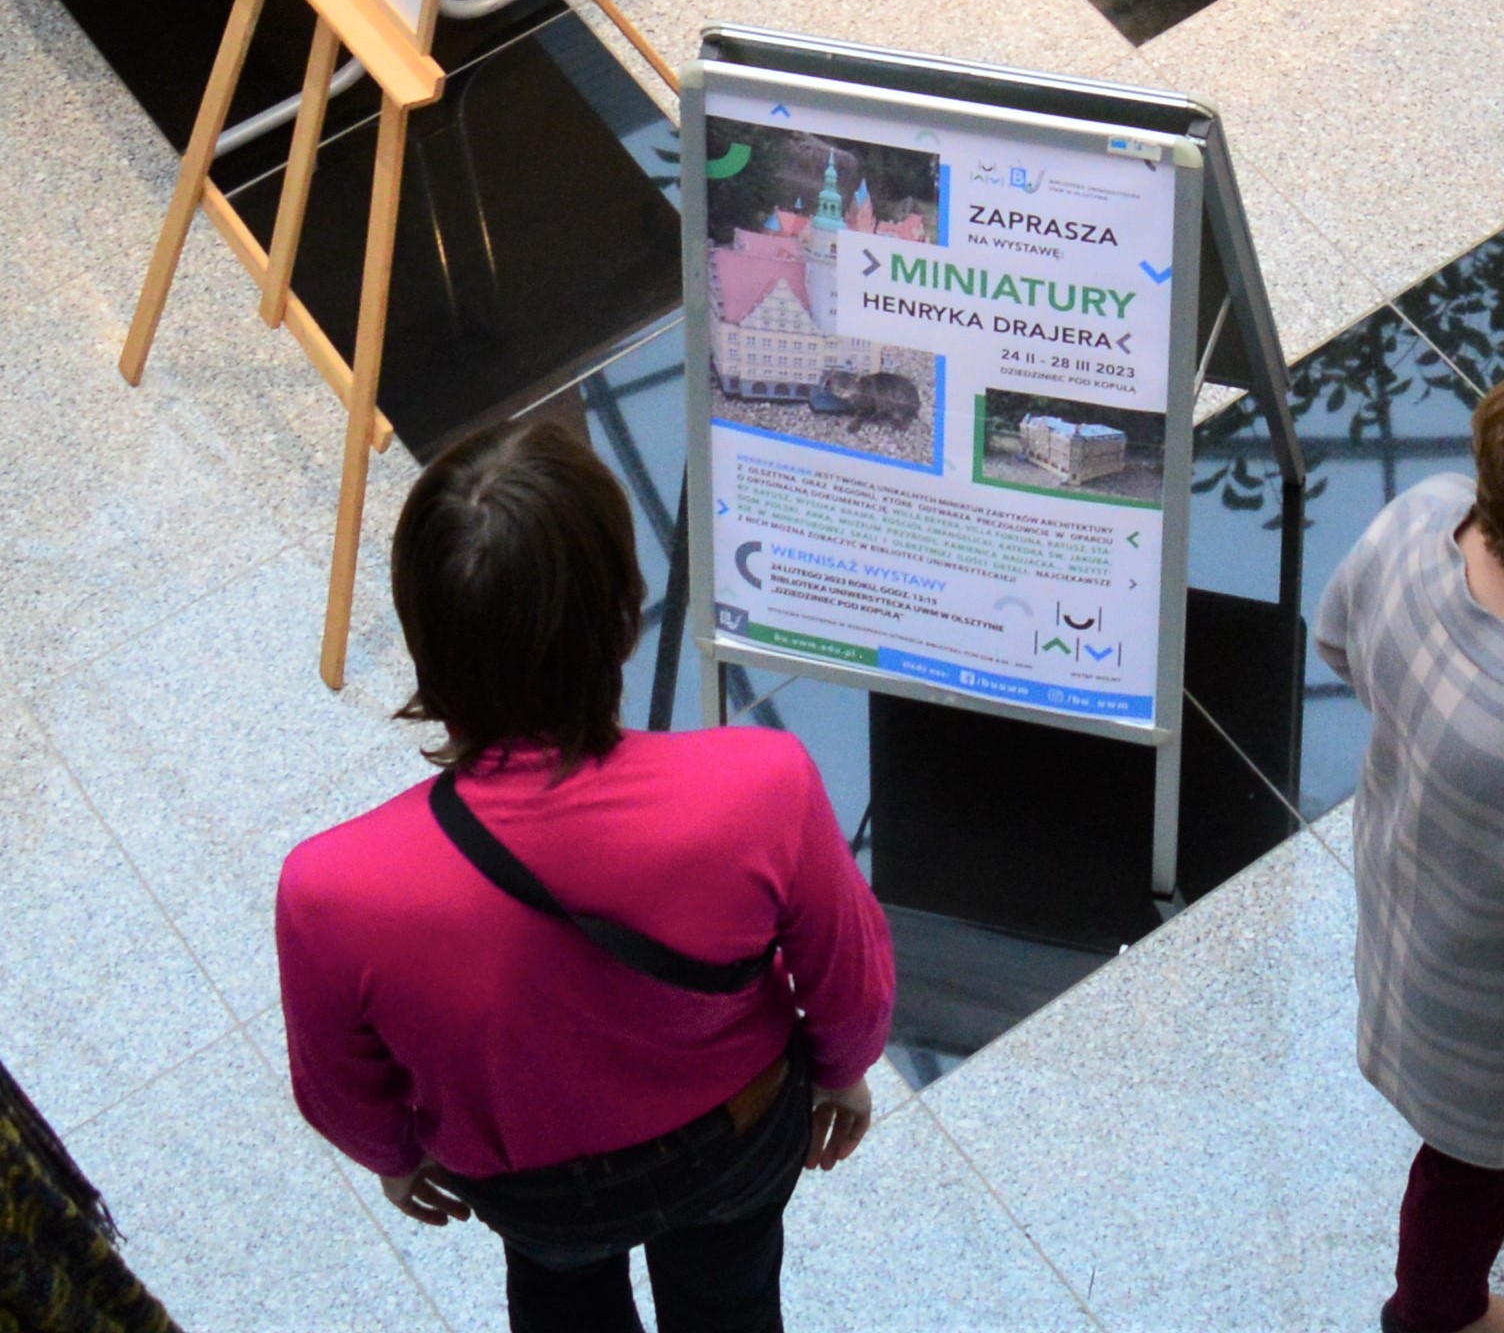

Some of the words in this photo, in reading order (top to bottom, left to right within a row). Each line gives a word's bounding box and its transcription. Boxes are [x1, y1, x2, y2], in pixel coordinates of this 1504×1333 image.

[968, 204, 1119, 247] ZAPRASZA
[968, 233, 988, 246] NA
[991, 237, 1064, 260] WYSTAWĘ:
[890, 253, 1135, 320] MINIATURY
[862, 291, 983, 330] HENRYKA
[993, 314, 1112, 351] DRAJERA
[1000, 347, 1020, 362] 24
[1025, 352, 1034, 364] II
[1051, 355, 1069, 369] 28
[1075, 359, 1090, 372] III
[1095, 361, 1135, 379] 2023
[1000, 365, 1065, 384] DZIEDZINIEC
[1067, 375, 1091, 387] POD
[1093, 379, 1137, 395] KOPUŁĄ
[770, 543, 857, 572] WERNISAŻ
[862, 564, 946, 593] WYSTAWY
[770, 562, 782, 572] 24
[782, 565, 822, 580] LUTEGO
[823, 573, 846, 585] 2023
[769, 573, 827, 593] BIBLIOTEKA
[828, 585, 911, 611] UNIWERSYTECKA
[912, 604, 938, 617] UWM
[938, 612, 949, 621] W
[950, 614, 1004, 633] OLSZTYNIE
[837, 599, 858, 611] POD
